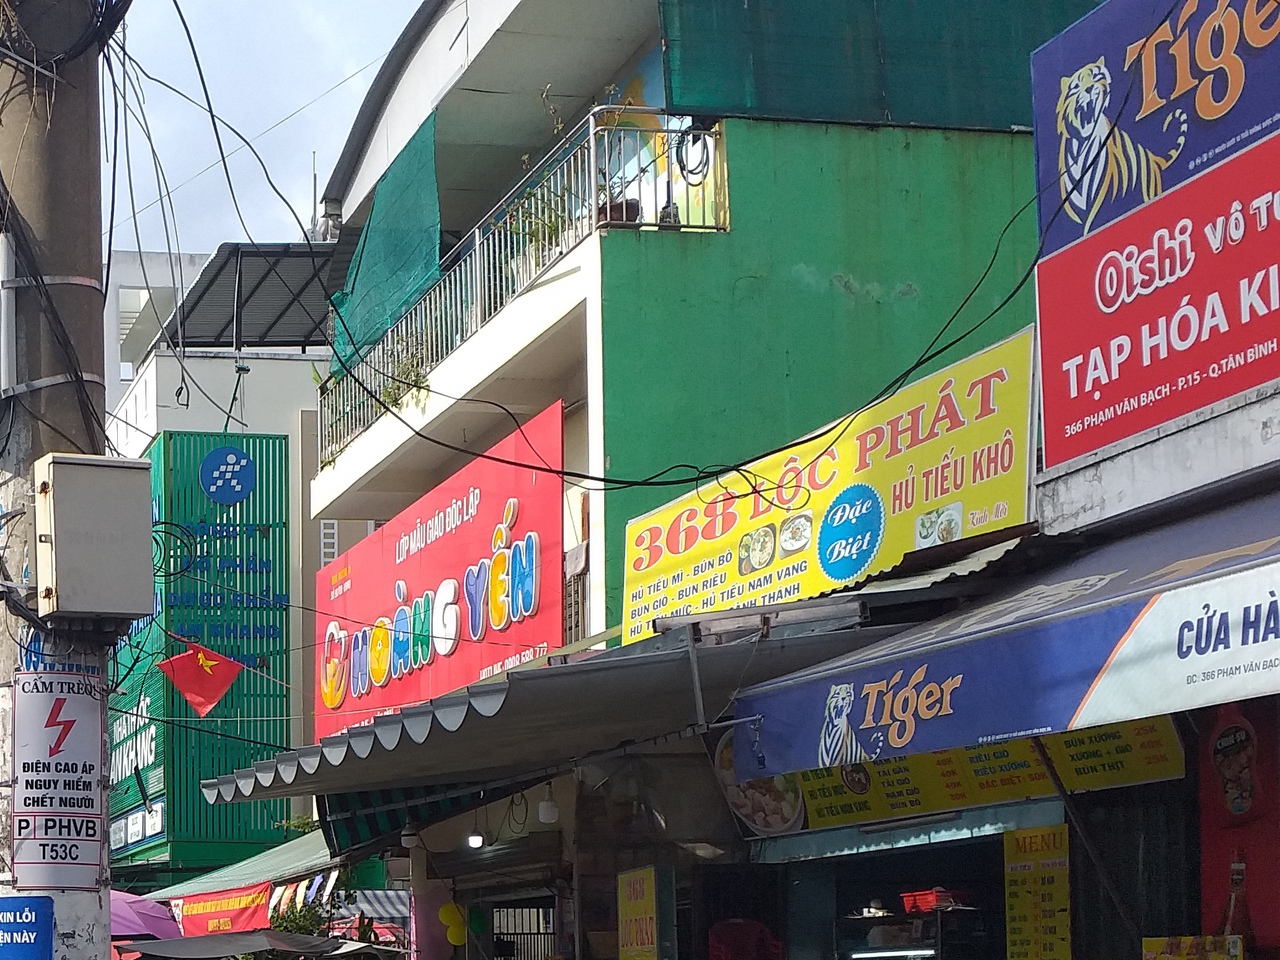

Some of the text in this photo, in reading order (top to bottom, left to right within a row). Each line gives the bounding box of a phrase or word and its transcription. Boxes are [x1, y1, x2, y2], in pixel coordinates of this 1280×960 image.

[1095, 190, 1280, 314] Oishi VÔ T
[1063, 334, 1132, 401] TẠP
[1141, 291, 1229, 367] HÓA
[1064, 420, 1083, 438] 366
[1084, 407, 1116, 431] PHẠM
[1115, 396, 1139, 417] VĂN
[1140, 382, 1171, 408] BẠCH
[1178, 370, 1201, 391] P.15
[1209, 352, 1245, 378] Q.TÂN
[1247, 338, 1278, 363] BÌNH
[632, 367, 1009, 571] 368 LỘC PHÁT
[891, 429, 1015, 516] HỦ TIẾU KHÔ
[395, 532, 410, 565] LỚP
[426, 509, 445, 545] GIÁO
[445, 498, 462, 535] ĐỘC
[463, 486, 481, 523] LẬP
[827, 498, 873, 527] Đặc
[826, 531, 873, 564] Biệt
[631, 588, 644, 603] HỦ
[647, 575, 669, 596] TIẾU
[671, 570, 683, 586] MÌ
[693, 556, 715, 577] BÚN
[718, 549, 733, 567] BÒ
[702, 593, 716, 610] HỦ
[720, 581, 745, 604] TIẾU
[748, 573, 773, 593] NAM
[776, 559, 808, 581] VANG
[350, 497, 542, 699] HOÀNG YẾN
[630, 602, 650, 620] BÚN
[652, 593, 668, 612] GIÒ
[678, 583, 699, 602] BÚN
[701, 571, 727, 591] RIÊU
[761, 582, 801, 607] THÁNH
[210, 624, 280, 639] KHANG
[630, 622, 643, 638] HỦ
[1177, 590, 1280, 660] CỬA HÀ
[22, 675, 97, 698] CẤM TRÈO!
[1186, 674, 1200, 685] ĐC:
[1201, 670, 1216, 682] 366
[1217, 664, 1241, 679] PHẠM
[1243, 660, 1261, 674] VĂN
[859, 663, 964, 749] Tiger
[22, 760, 96, 777] ĐIỆN CAO ÁP
[25, 774, 93, 792] NGUY HIỂM
[23, 792, 95, 810] CHẾT NGƯỜI
[17, 818, 31, 838] P
[43, 818, 98, 838] PHVB
[1014, 831, 1063, 854] MENU
[38, 843, 80, 861] T53C
[16, 907, 36, 923] LỖI
[13, 930, 37, 944] NÀY
